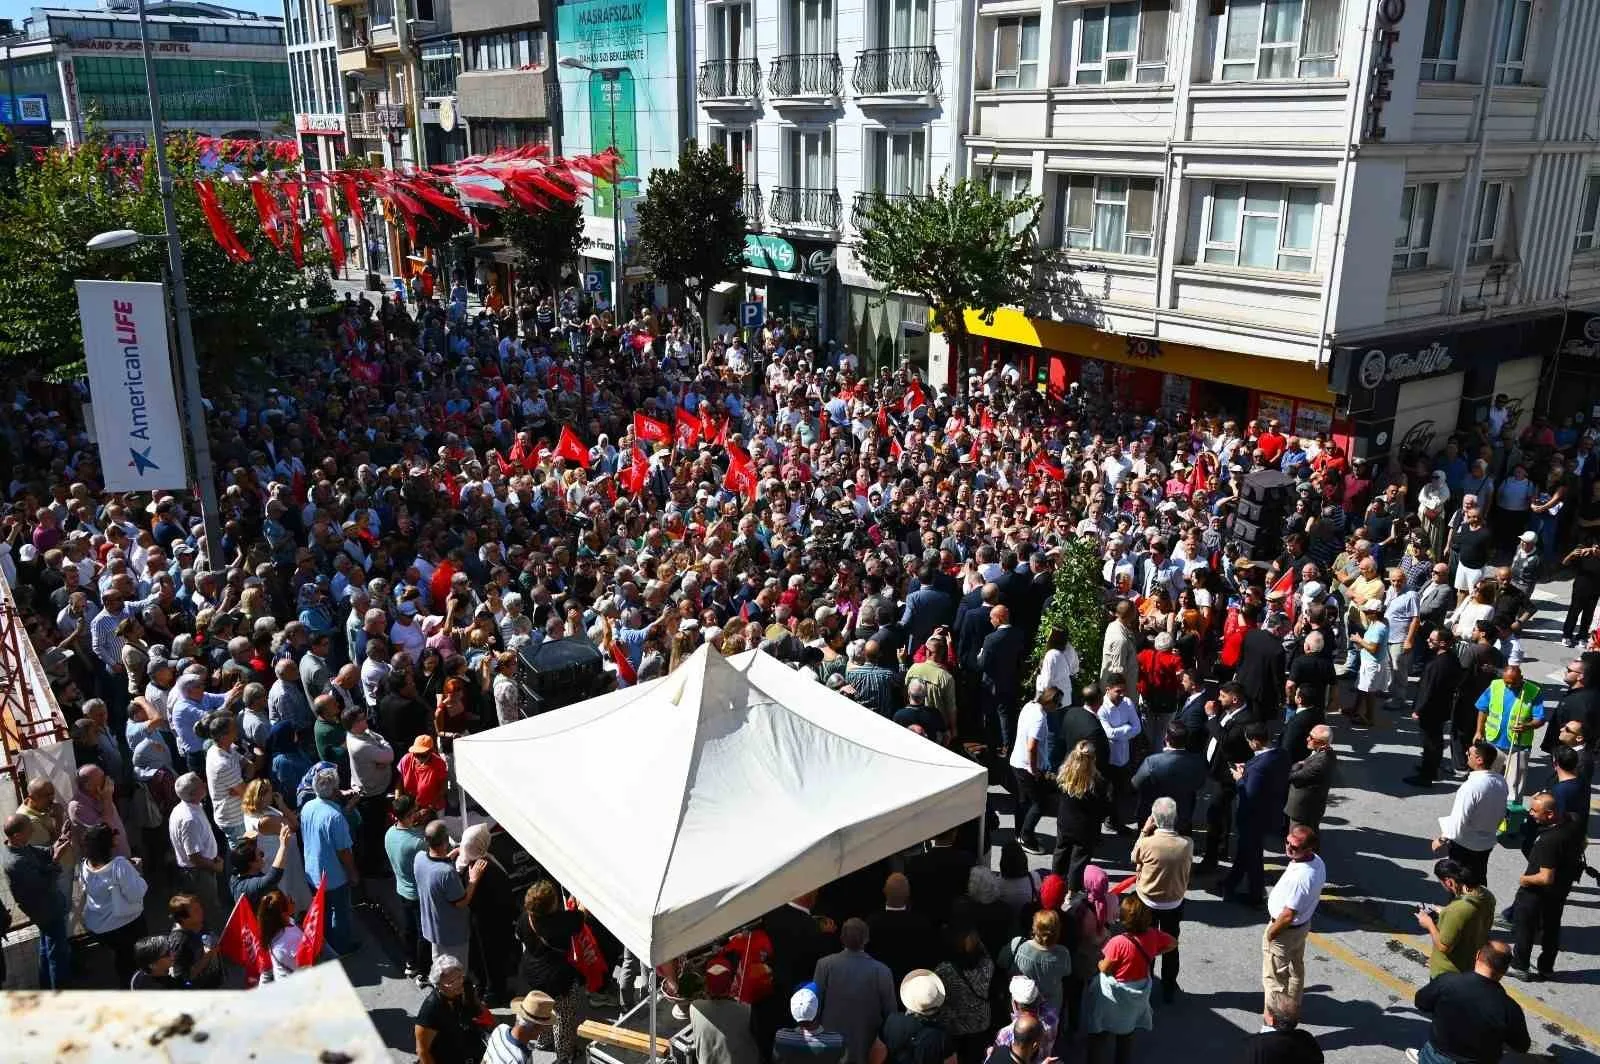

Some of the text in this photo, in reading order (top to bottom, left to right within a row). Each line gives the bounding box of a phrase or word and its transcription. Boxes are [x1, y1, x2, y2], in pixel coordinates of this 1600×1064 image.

[578, 4, 642, 24] MASRAFSIZLIK
[159, 43, 191, 52] HOTEL
[745, 305, 758, 320] P
